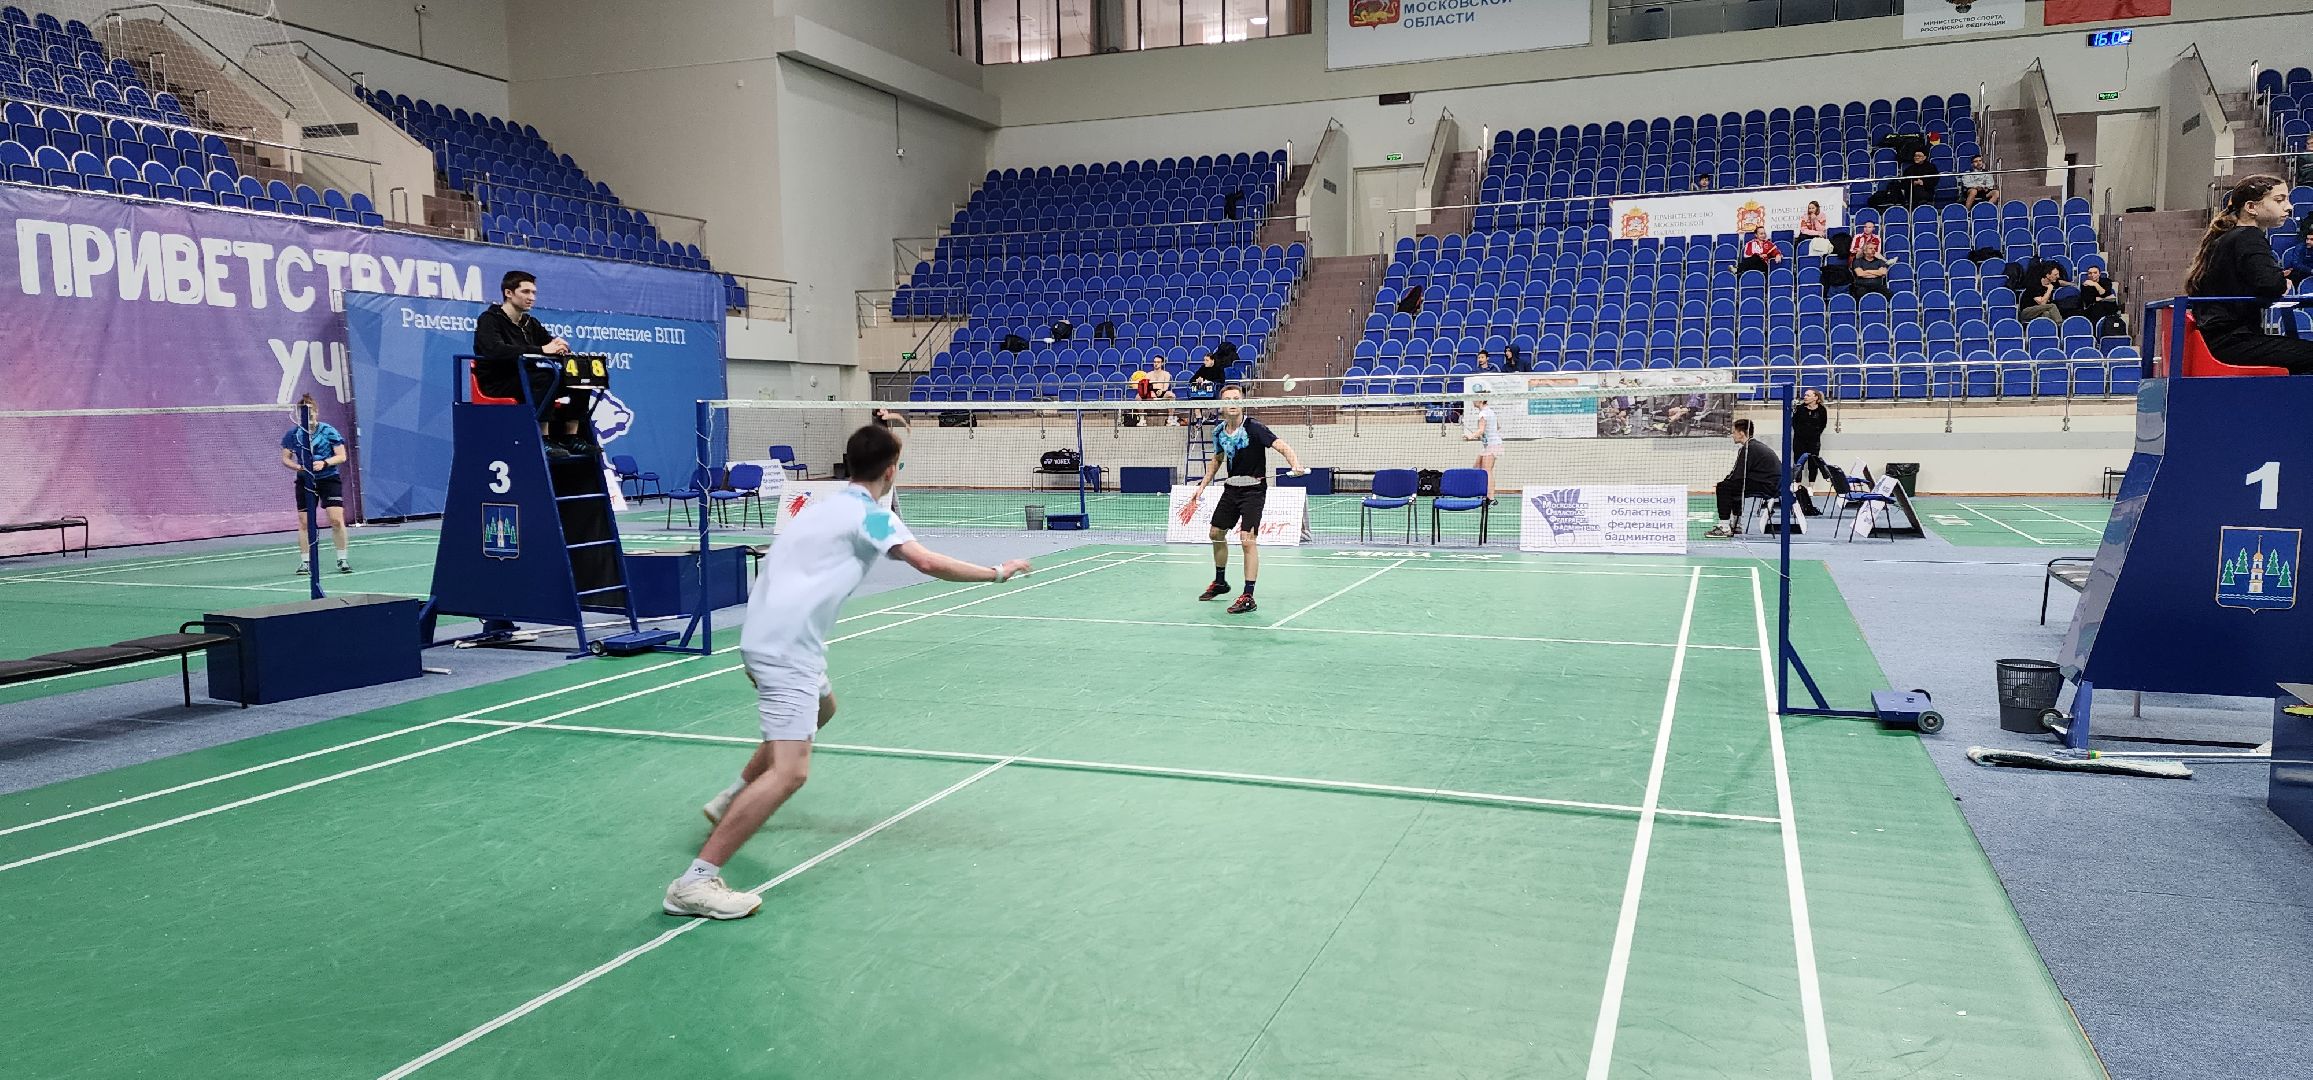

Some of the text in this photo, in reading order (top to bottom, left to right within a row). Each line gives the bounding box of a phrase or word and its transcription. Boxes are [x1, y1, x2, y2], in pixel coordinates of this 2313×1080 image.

[1403, 11, 1475, 28] ОБЛАСТИ
[1920, 20, 2006, 33] РОССИЙСКОЙ ФЕДЕРАЦИИ
[1923, 14, 2003, 27] МИНИСТЕРСТВО СПОРТА
[16, 218, 483, 313] ПРИВЕТСТВУЕМ
[575, 325, 652, 342] отделение
[655, 327, 686, 345] ВПП
[565, 359, 579, 376] 4
[591, 360, 606, 377] 8
[488, 460, 511, 494] 3
[2245, 461, 2281, 510] 1
[1607, 495, 1676, 504] Московская
[1611, 507, 1671, 516] областная
[1607, 519, 1674, 531] федерация
[1604, 531, 1676, 542] бадминтона
